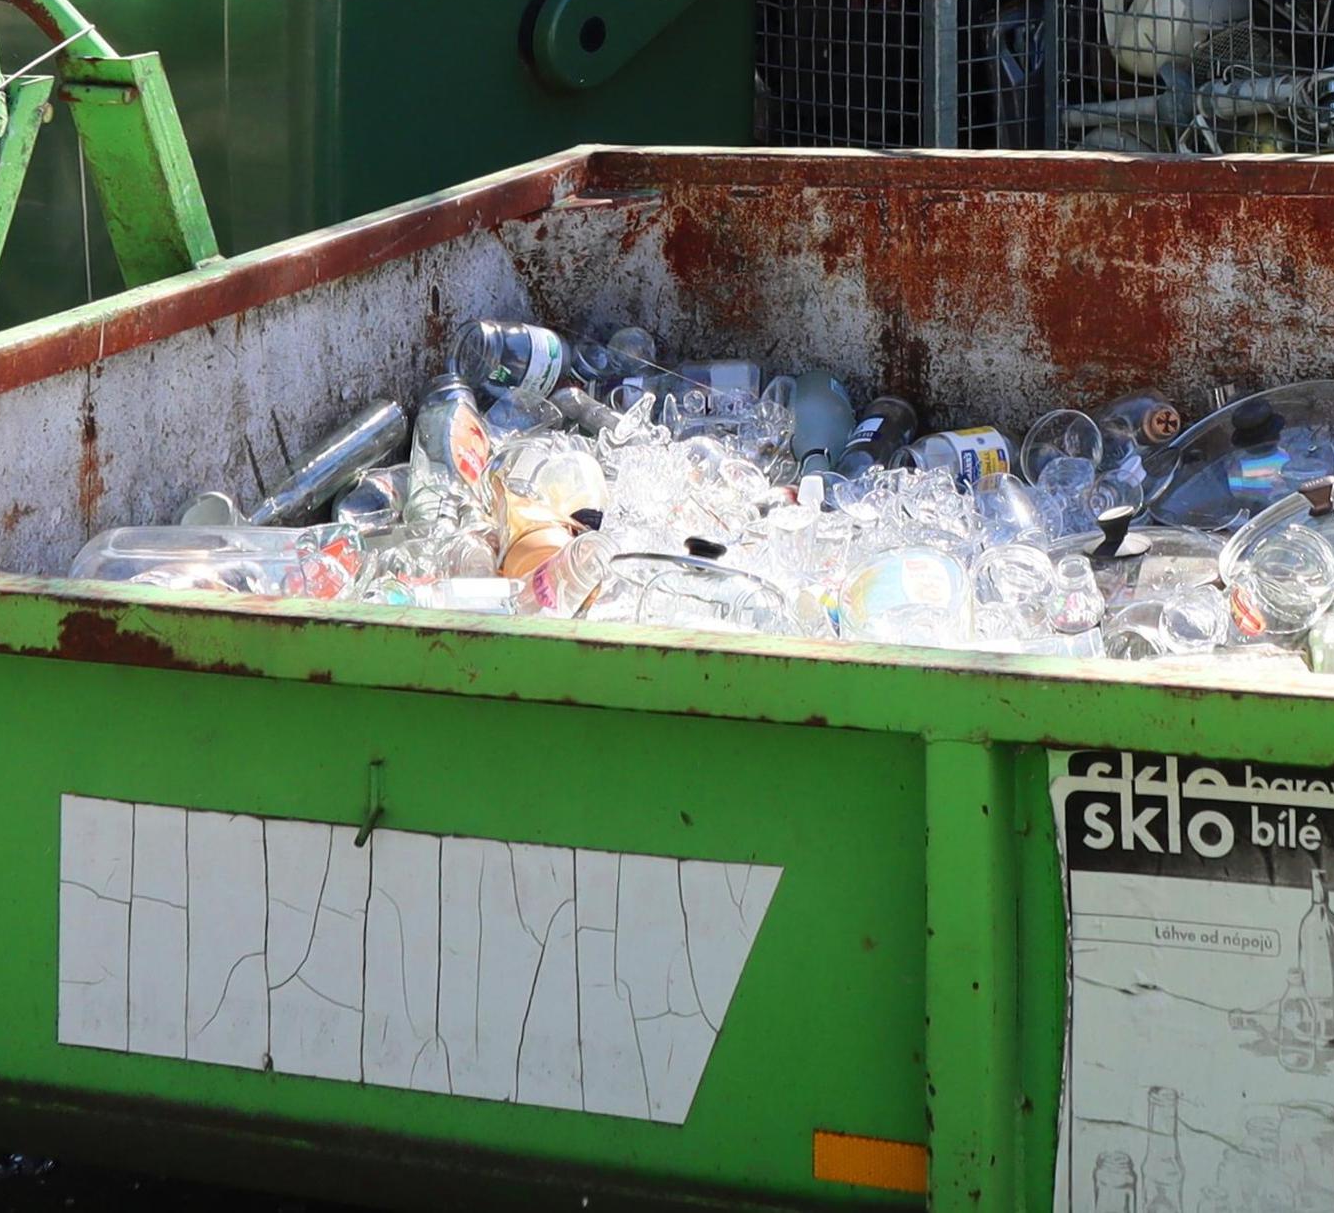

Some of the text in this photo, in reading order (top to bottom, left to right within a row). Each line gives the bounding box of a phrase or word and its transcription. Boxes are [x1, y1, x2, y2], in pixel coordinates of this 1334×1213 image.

[1082, 790, 1322, 859] sklo bílé
[1154, 924, 1273, 952] Láhve od nápojů
